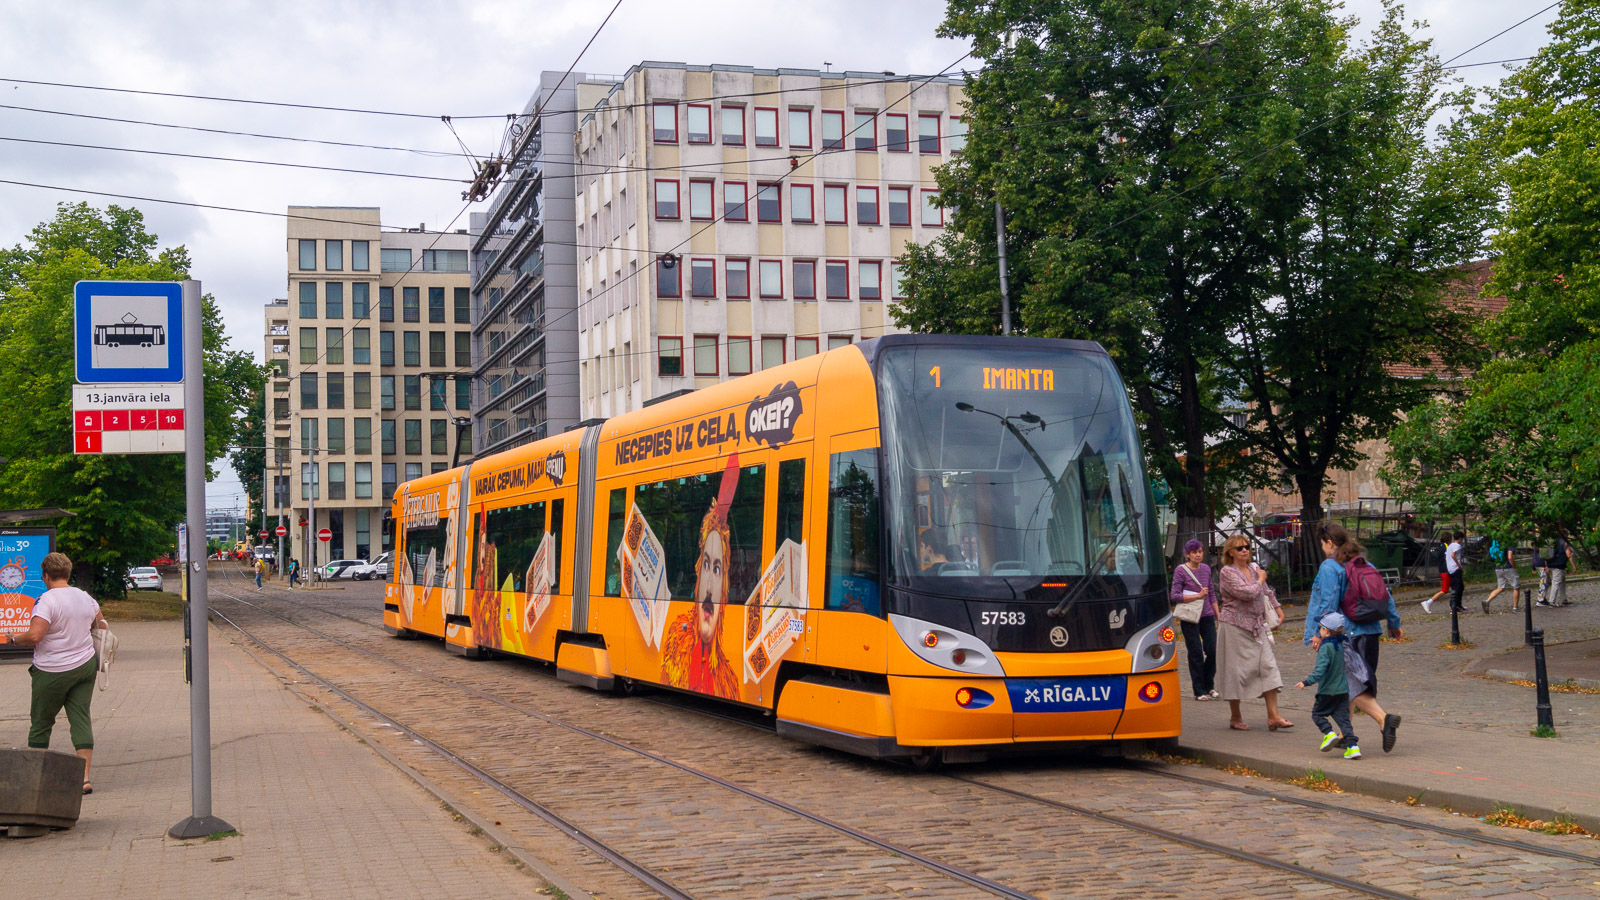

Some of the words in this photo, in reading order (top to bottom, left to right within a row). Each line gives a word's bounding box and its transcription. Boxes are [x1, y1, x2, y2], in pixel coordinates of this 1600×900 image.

[929, 366, 941, 388] 1
[982, 367, 1054, 391] IMANTA
[150, 392, 171, 403] iela
[112, 416, 119, 424] 2
[140, 416, 146, 424] 5
[165, 415, 177, 423] 10
[615, 429, 673, 466] NECEPIES
[675, 423, 694, 453] UZ
[750, 396, 794, 434] OKEI?
[86, 436, 91, 449] 1
[981, 611, 1026, 626] 57583
[788, 619, 803, 632] 57583
[1043, 685, 1112, 703] RĪGA.LV
